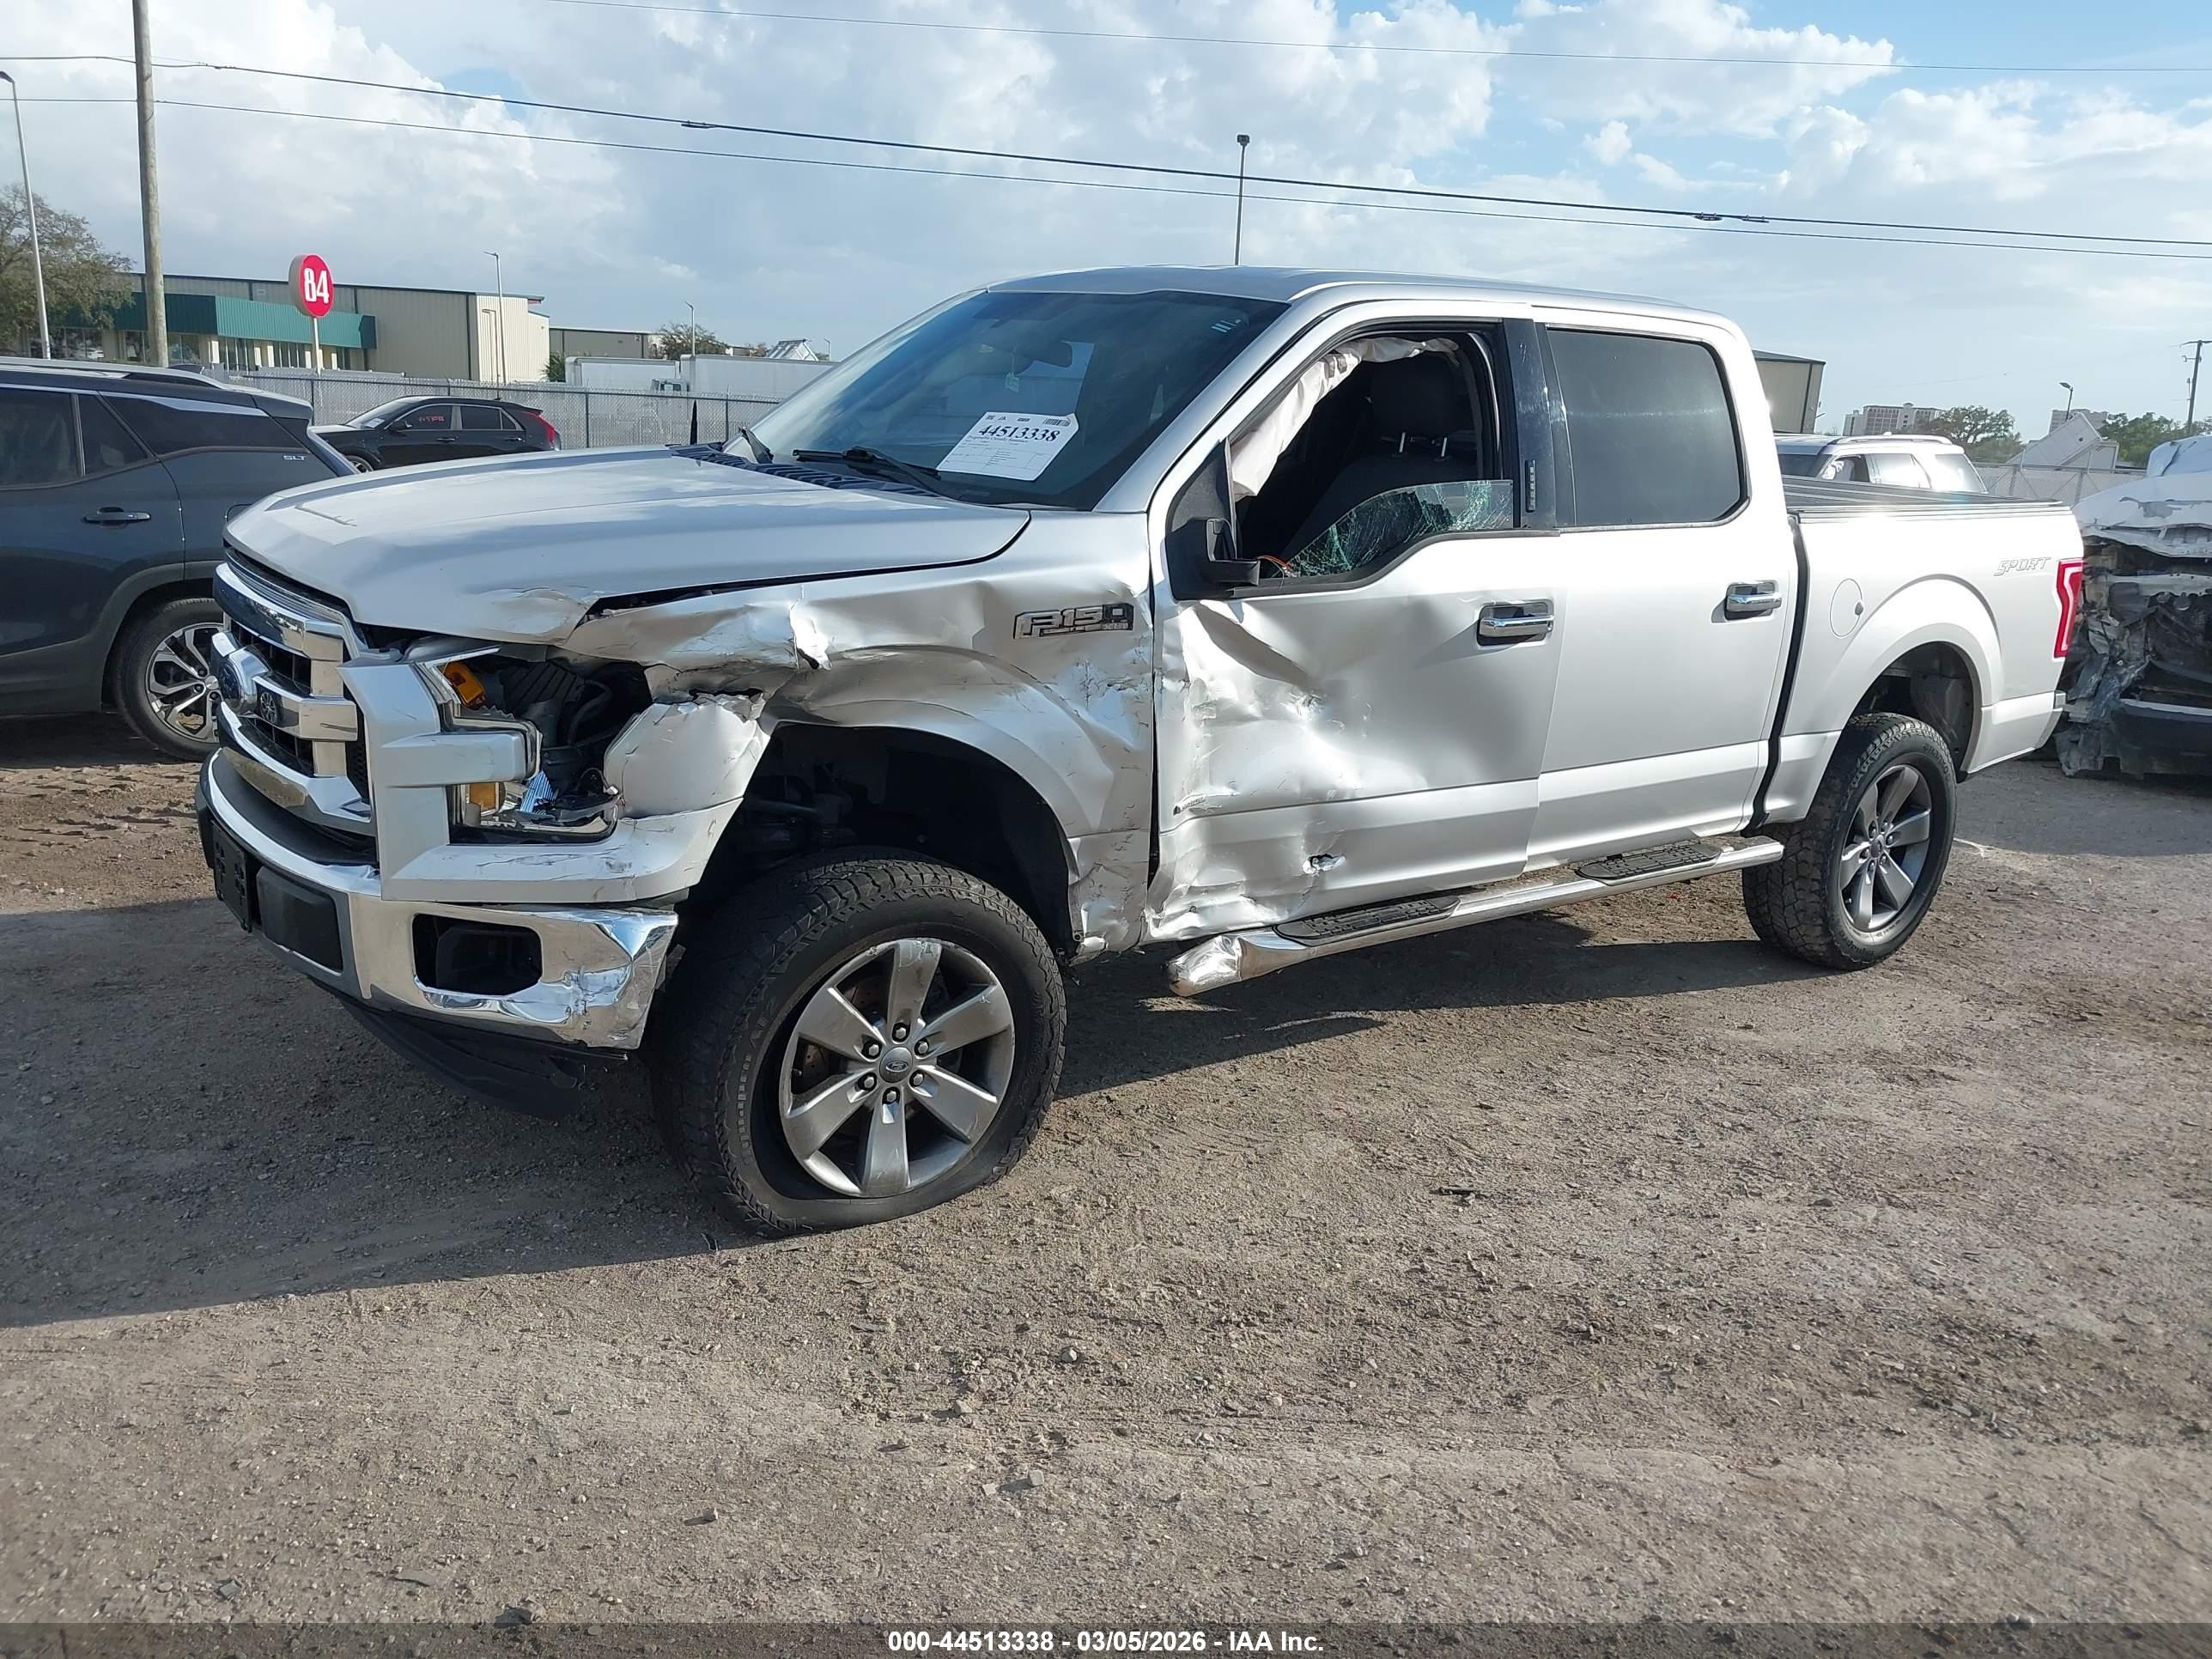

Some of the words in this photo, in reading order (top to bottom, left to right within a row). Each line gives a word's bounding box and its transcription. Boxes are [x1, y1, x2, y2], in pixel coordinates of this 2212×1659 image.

[304, 267, 330, 304] 84
[978, 424, 1060, 442] 44513338
[1993, 556, 2051, 576] SPORT
